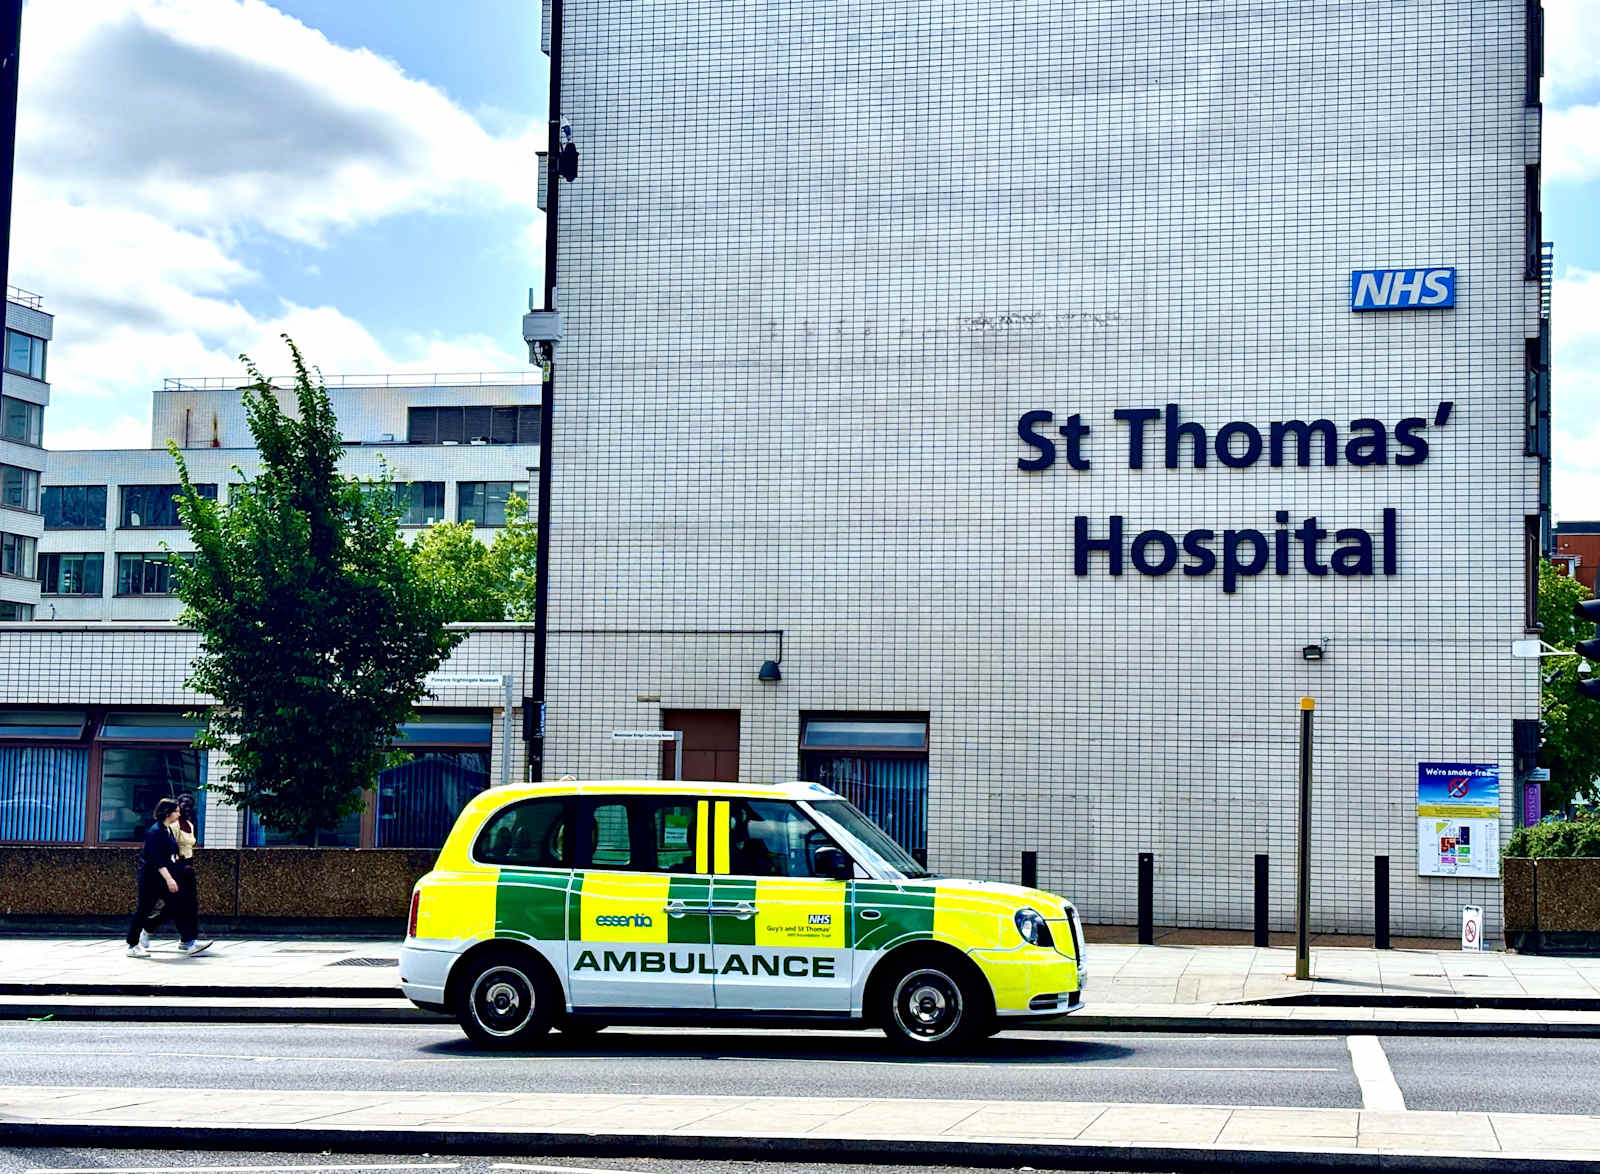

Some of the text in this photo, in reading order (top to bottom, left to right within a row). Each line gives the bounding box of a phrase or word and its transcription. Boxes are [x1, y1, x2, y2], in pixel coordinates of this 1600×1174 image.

[1353, 268, 1452, 307] NHS
[1016, 401, 1455, 471] St Thomas'
[1073, 507, 1398, 593] Hospital
[1425, 767, 1447, 776] We're
[595, 913, 653, 928] essentia
[808, 914, 831, 924] NHS
[573, 950, 836, 978] AMBULANCE
